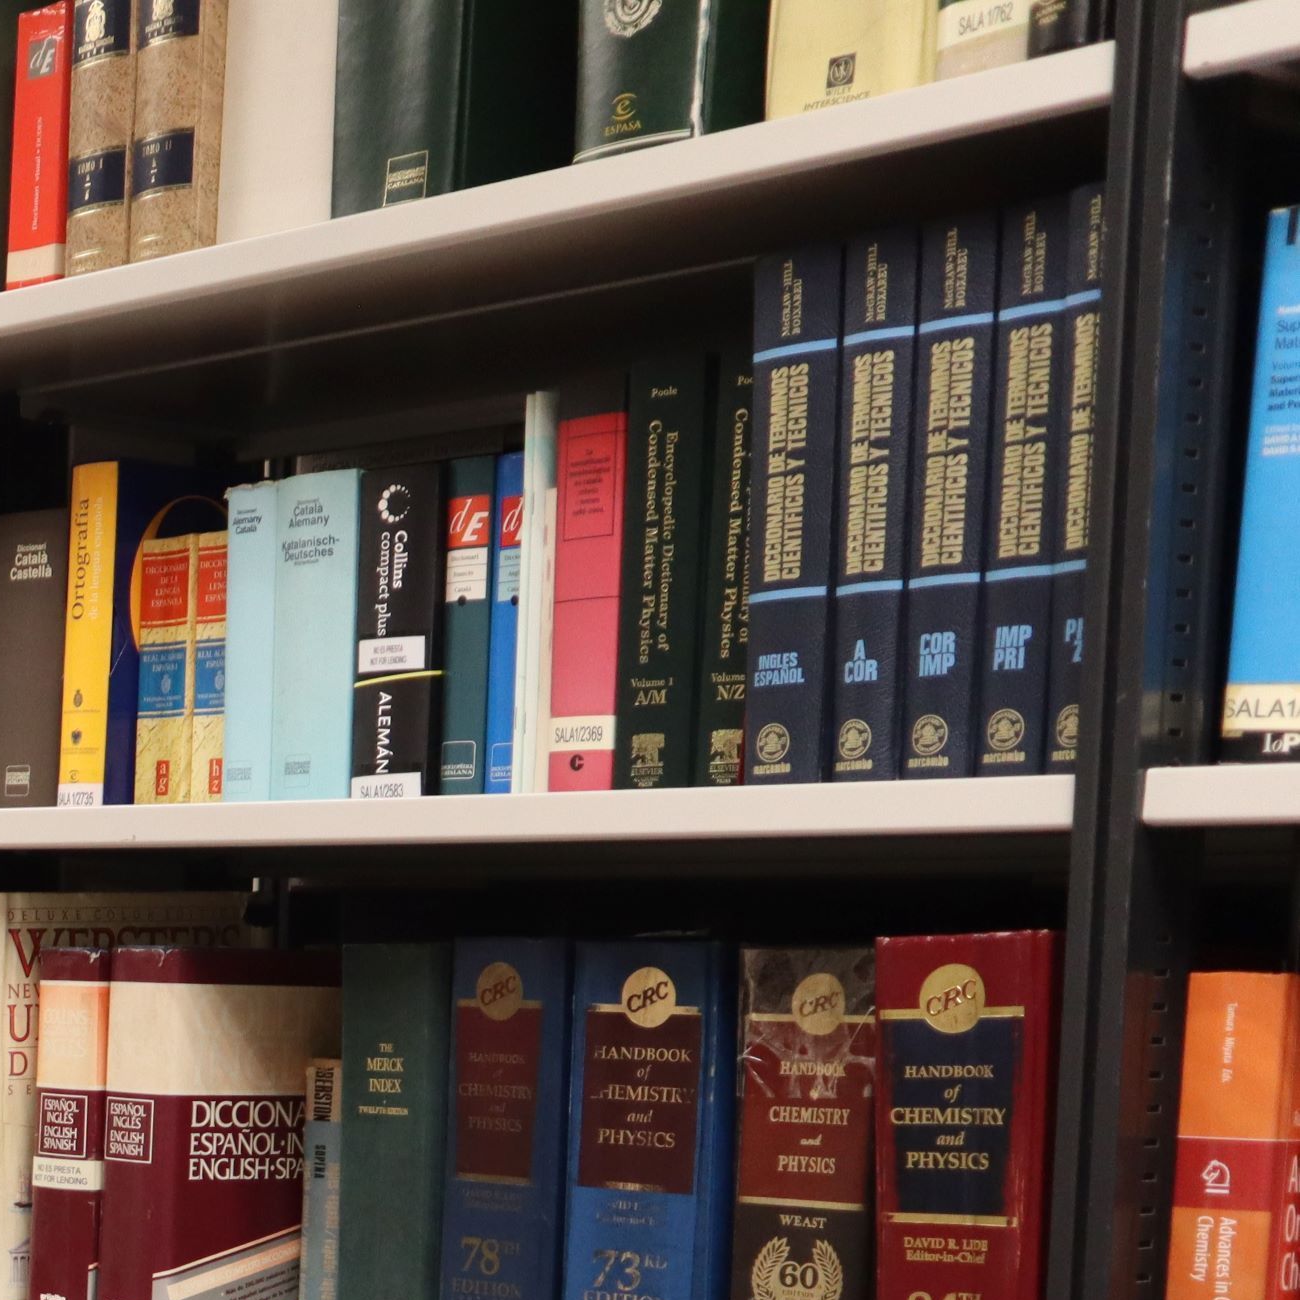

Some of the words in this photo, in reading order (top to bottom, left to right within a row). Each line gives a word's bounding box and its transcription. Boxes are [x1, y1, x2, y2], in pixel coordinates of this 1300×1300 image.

[803, 90, 871, 113] INTERSCIENCE
[604, 118, 642, 137] ESPASA
[651, 386, 678, 399] Poole
[852, 353, 873, 441] TERMINOS
[729, 408, 749, 513] Condensed
[850, 440, 870, 465] DE
[288, 514, 330, 529] Alemany
[846, 464, 868, 575] DICCIONARIO
[282, 535, 340, 553] Katalanisch-
[725, 518, 743, 581] Matter
[15, 551, 48, 566] Català
[71, 498, 91, 621] Ortografía
[284, 547, 334, 562] Deutsches
[392, 529, 408, 589] Collins
[10, 564, 52, 581] Castellà
[376, 531, 391, 599] compact
[375, 604, 391, 636] plus
[720, 586, 738, 659] Physics
[995, 624, 1033, 648] IMP
[758, 651, 799, 670] INGLES
[993, 647, 1025, 671] PRI
[844, 659, 878, 684] COR
[376, 691, 393, 775] ALEMÁN
[554, 726, 603, 744] SALA1/2369
[480, 976, 517, 1006] CRC
[626, 981, 669, 1013] CRC
[926, 978, 977, 1017] CRC
[379, 1043, 394, 1053] THE
[593, 1046, 692, 1063] HANDBOOK
[366, 1057, 404, 1072] MERCK
[904, 1064, 994, 1079] HANDBOOK
[369, 1078, 402, 1093] INDEX
[943, 1083, 962, 1103] of
[46, 1111, 74, 1125] INGLÉS
[769, 1105, 851, 1126] CHEMISTRY
[889, 1107, 1007, 1126] CHEMISTRY
[43, 1125, 77, 1139] ENGLISH
[597, 1128, 676, 1148] PHYSICS
[936, 1131, 966, 1147] and
[43, 1138, 77, 1151] SPANISH
[905, 1151, 990, 1170] PHYSICS
[779, 1213, 828, 1230] WEAST
[906, 1248, 986, 1264] Editor-in-Chief
[1190, 1215, 1214, 1283] Chemistry
[1215, 1216, 1238, 1279] Advances
[778, 1263, 820, 1291] 60
[1215, 1282, 1231, 1297] in
